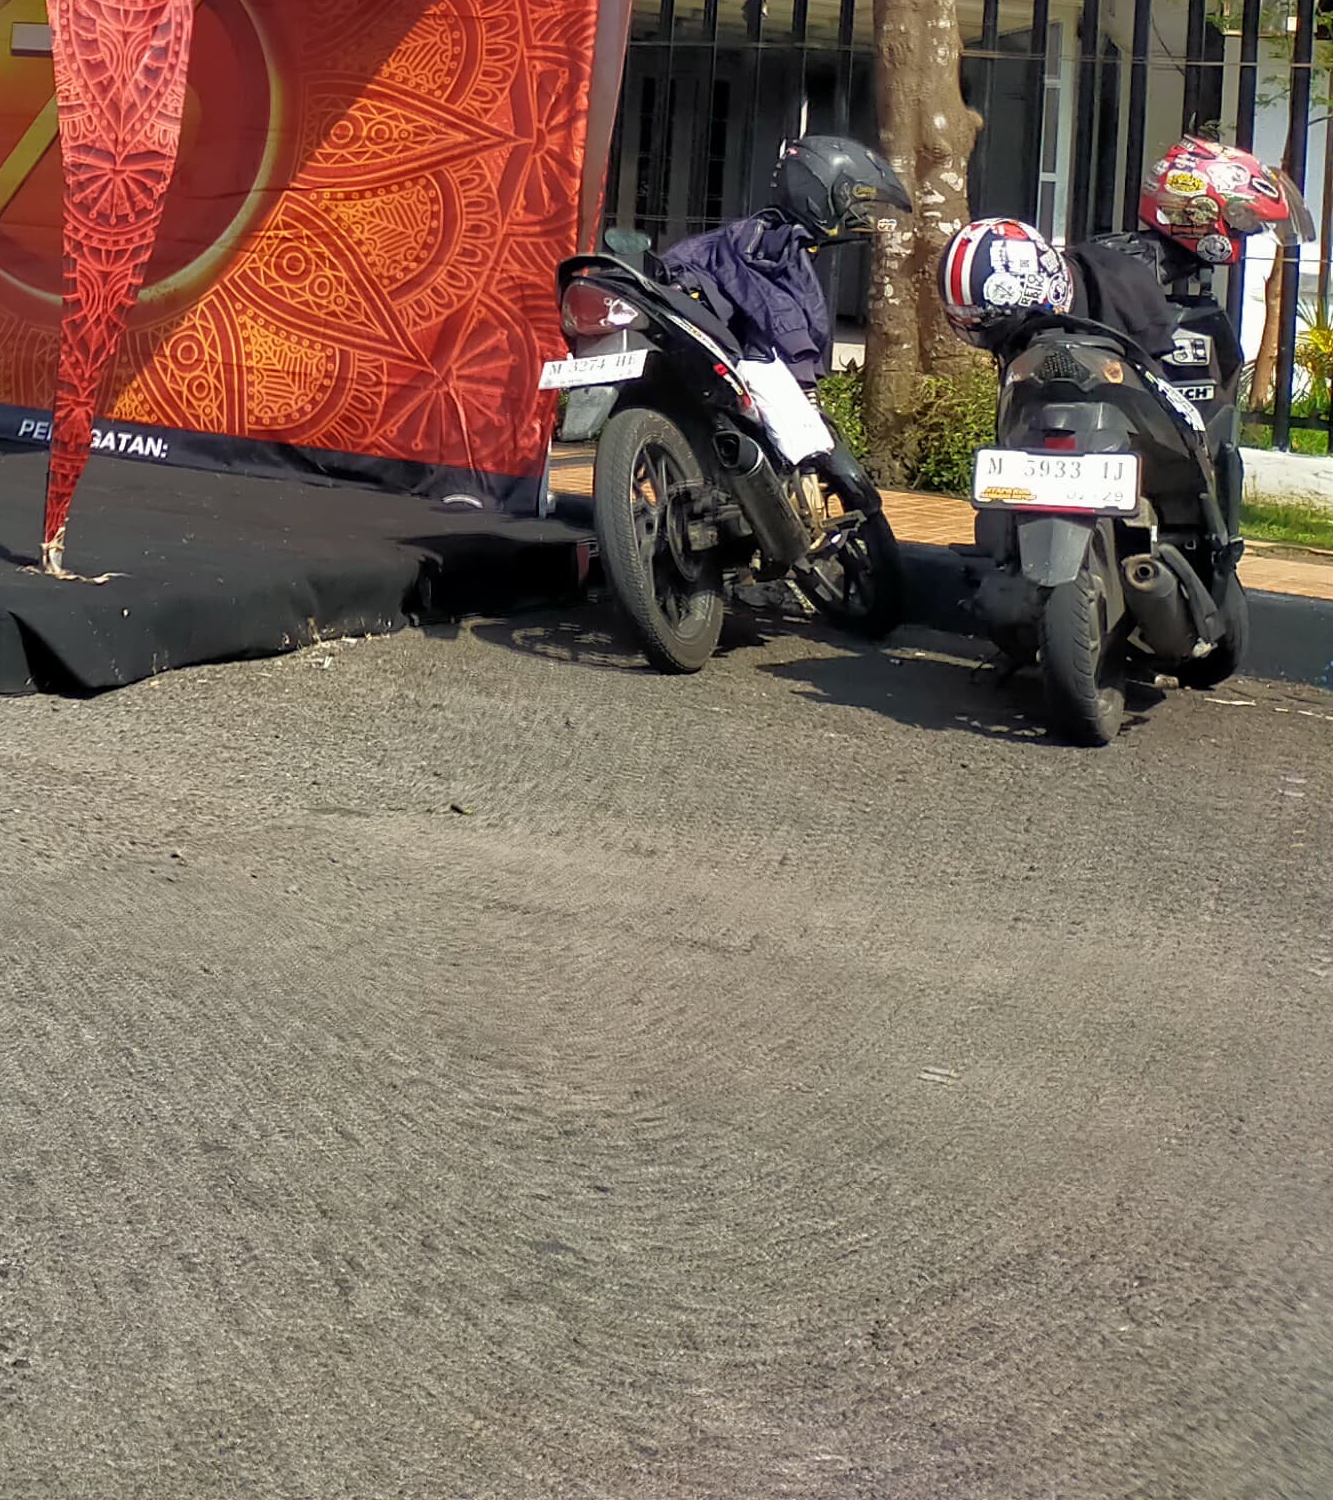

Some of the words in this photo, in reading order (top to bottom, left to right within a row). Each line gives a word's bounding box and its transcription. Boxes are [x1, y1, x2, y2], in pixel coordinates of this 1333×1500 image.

[549, 363, 563, 375] M
[988, 457, 1003, 475] M
[1024, 459, 1082, 480] 5933
